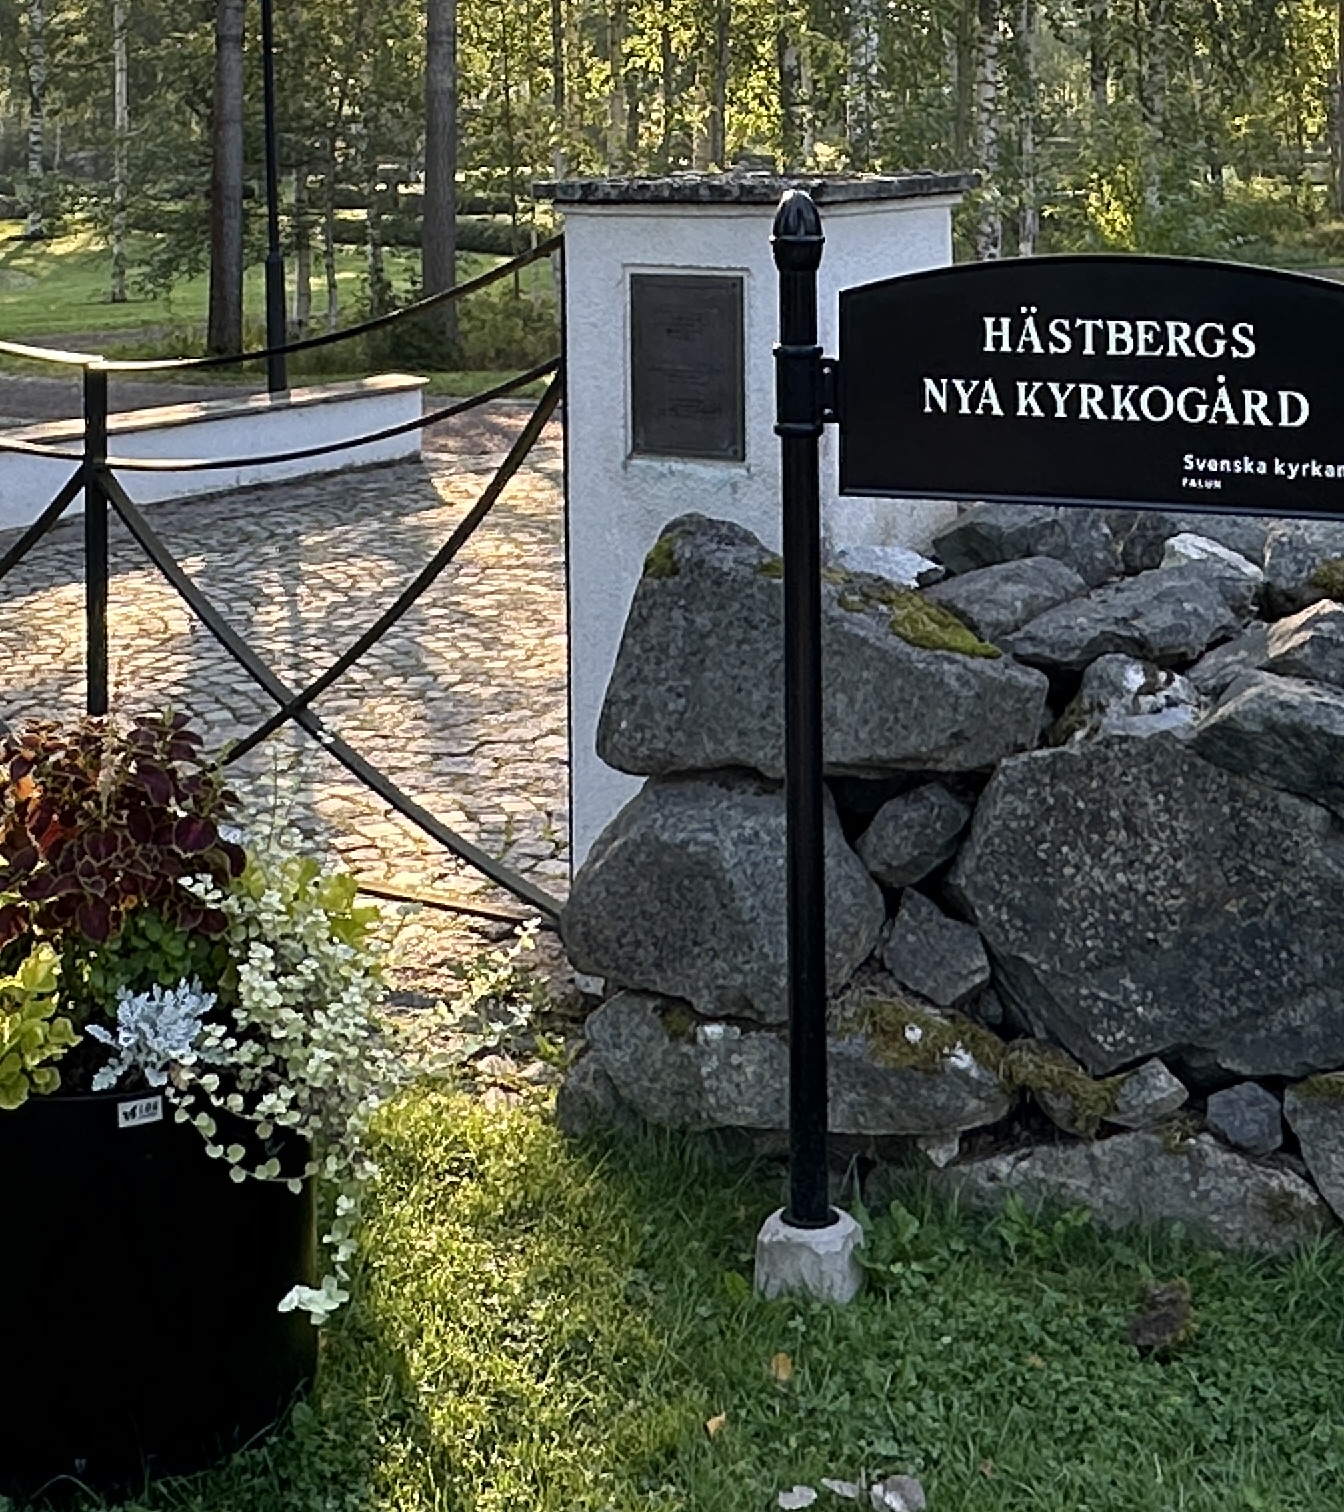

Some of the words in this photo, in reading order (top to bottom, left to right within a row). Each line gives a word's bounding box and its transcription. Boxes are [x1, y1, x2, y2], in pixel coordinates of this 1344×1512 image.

[982, 306, 1256, 359] HÄSTBERGS
[922, 377, 1004, 416] NYA
[1015, 374, 1310, 428] KYRKOGÅRD
[1183, 454, 1267, 475] Svenska
